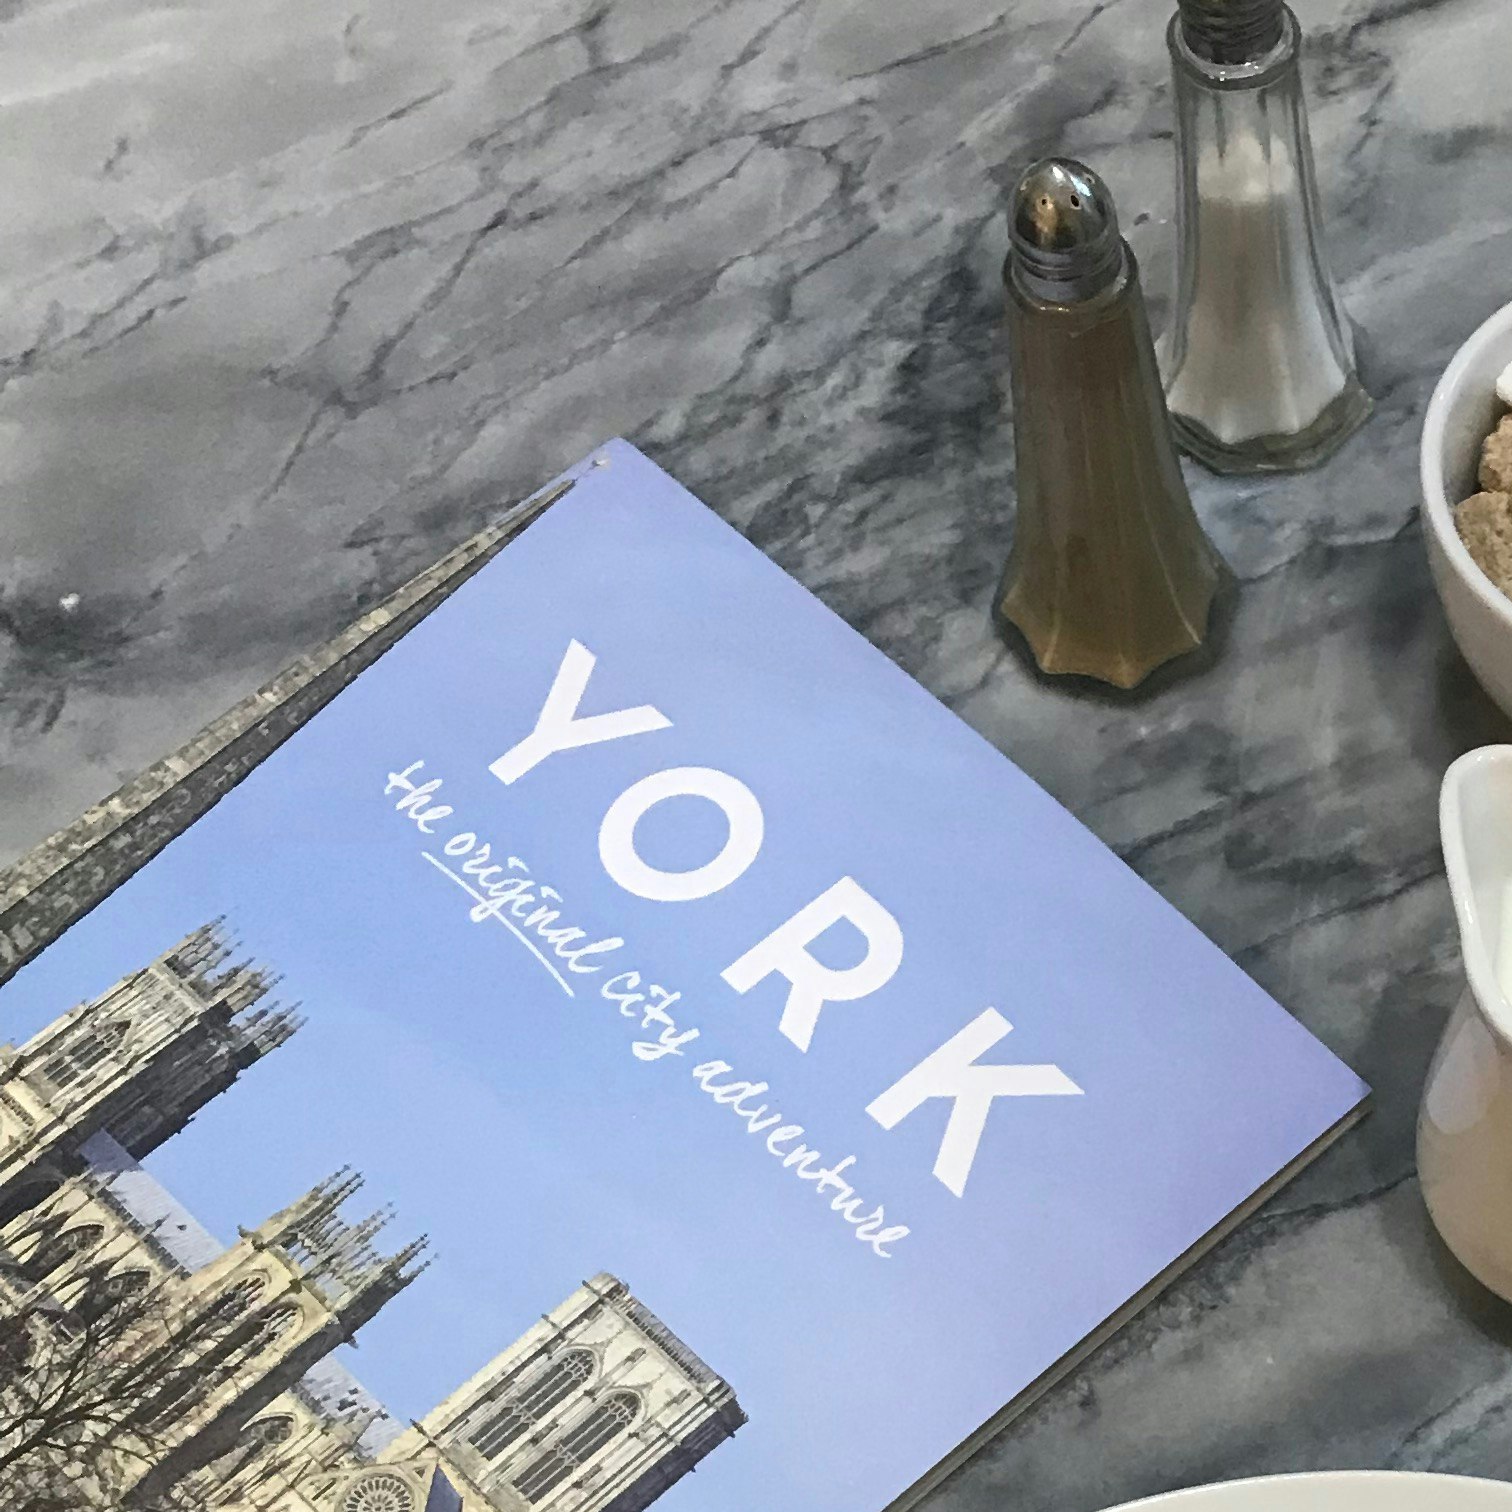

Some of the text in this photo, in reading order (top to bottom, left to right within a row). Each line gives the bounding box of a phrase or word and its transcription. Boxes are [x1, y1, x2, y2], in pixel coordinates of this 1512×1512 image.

[384, 760, 911, 1258] the original city adventure
[488, 638, 1085, 1199] YORK
